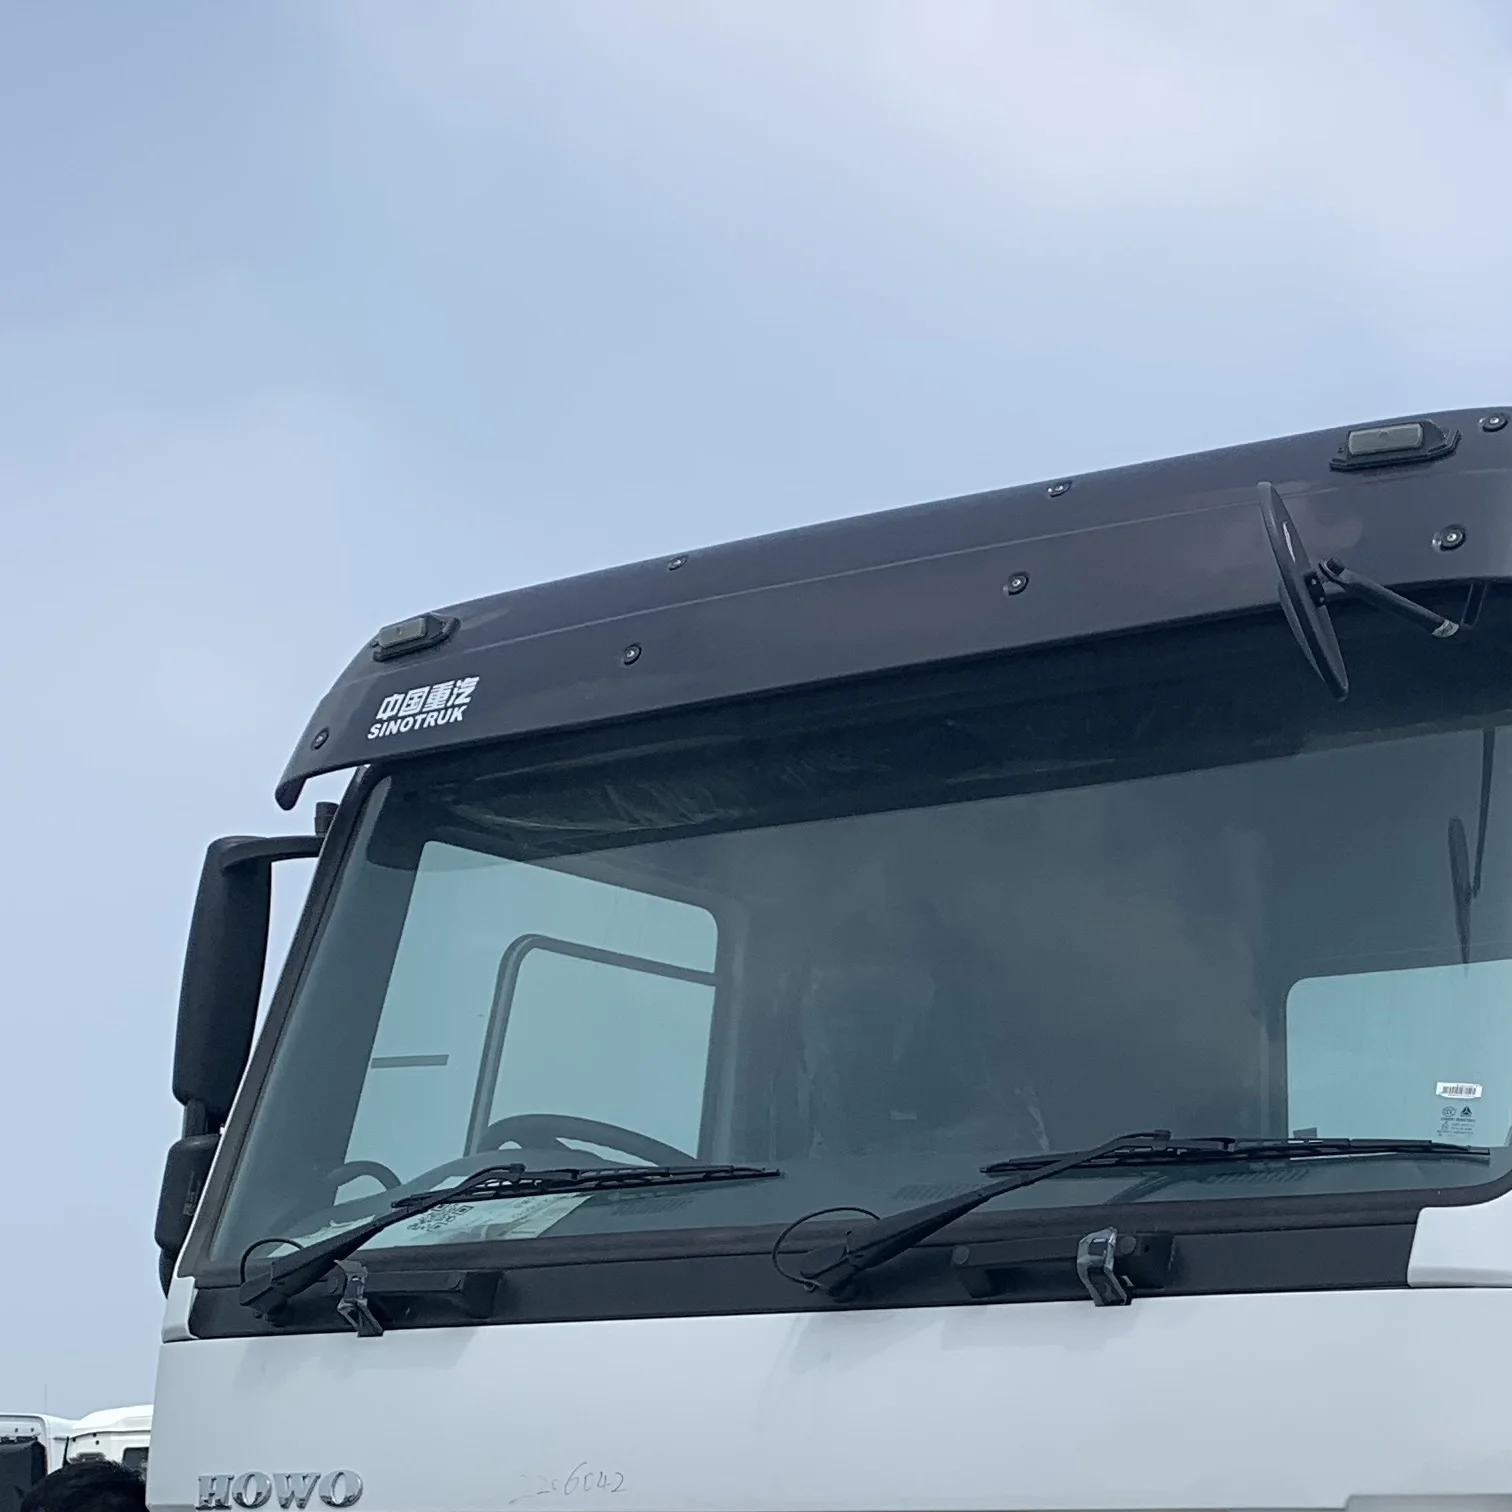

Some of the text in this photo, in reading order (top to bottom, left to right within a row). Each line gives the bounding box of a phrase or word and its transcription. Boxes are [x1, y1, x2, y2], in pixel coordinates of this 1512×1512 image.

[375, 676, 480, 720] 中国重汽
[367, 705, 468, 739] SINOTRUK
[195, 1470, 364, 1510] HOWO
